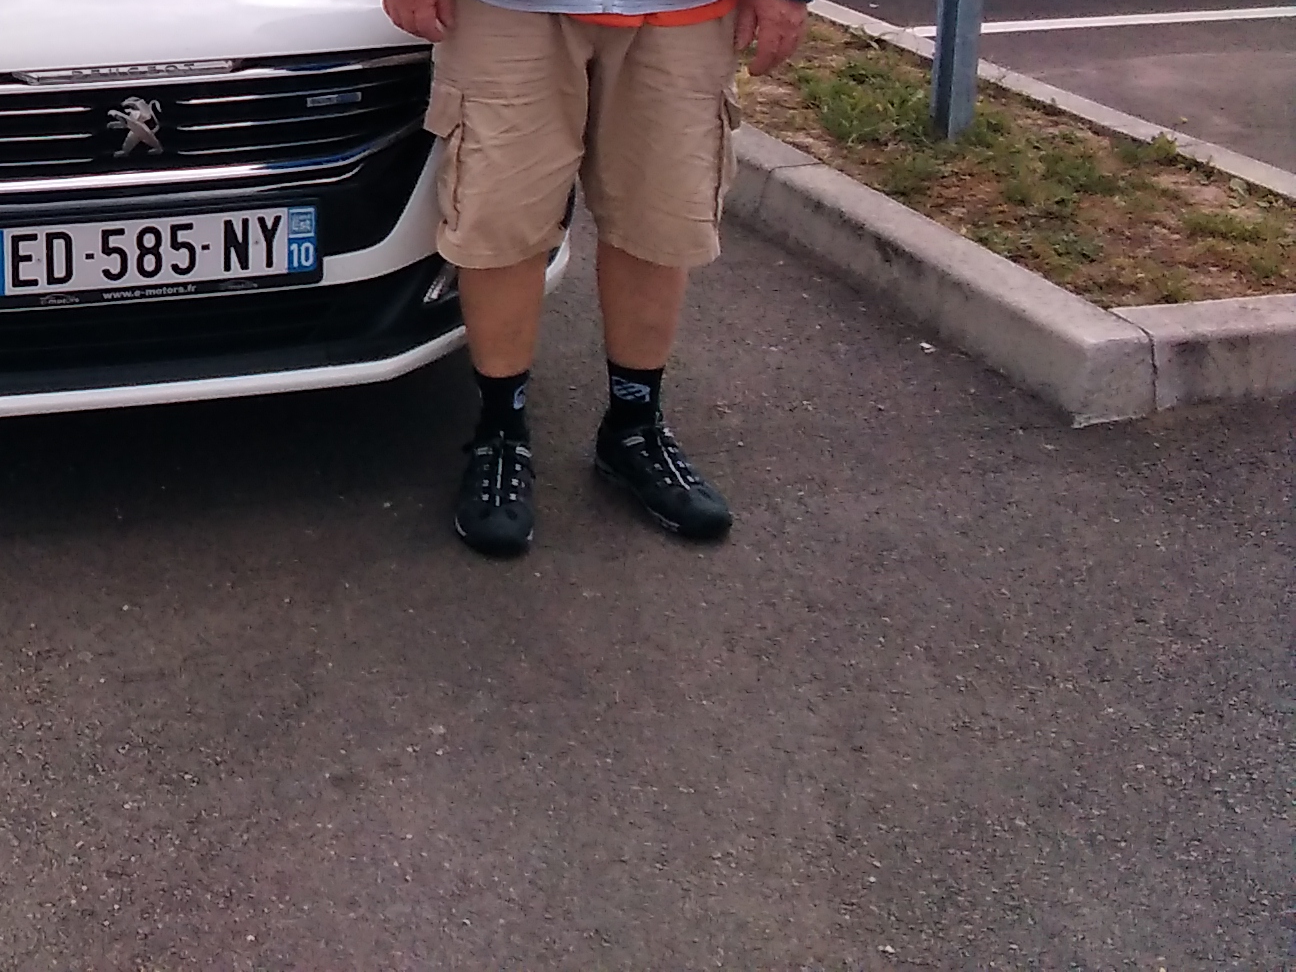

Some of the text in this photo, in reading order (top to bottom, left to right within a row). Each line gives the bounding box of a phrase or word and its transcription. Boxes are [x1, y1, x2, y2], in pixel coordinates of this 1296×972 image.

[10, 214, 283, 289] ED-585-NY
[290, 242, 314, 267] 10
[103, 284, 197, 301] www.e-motors.fr
